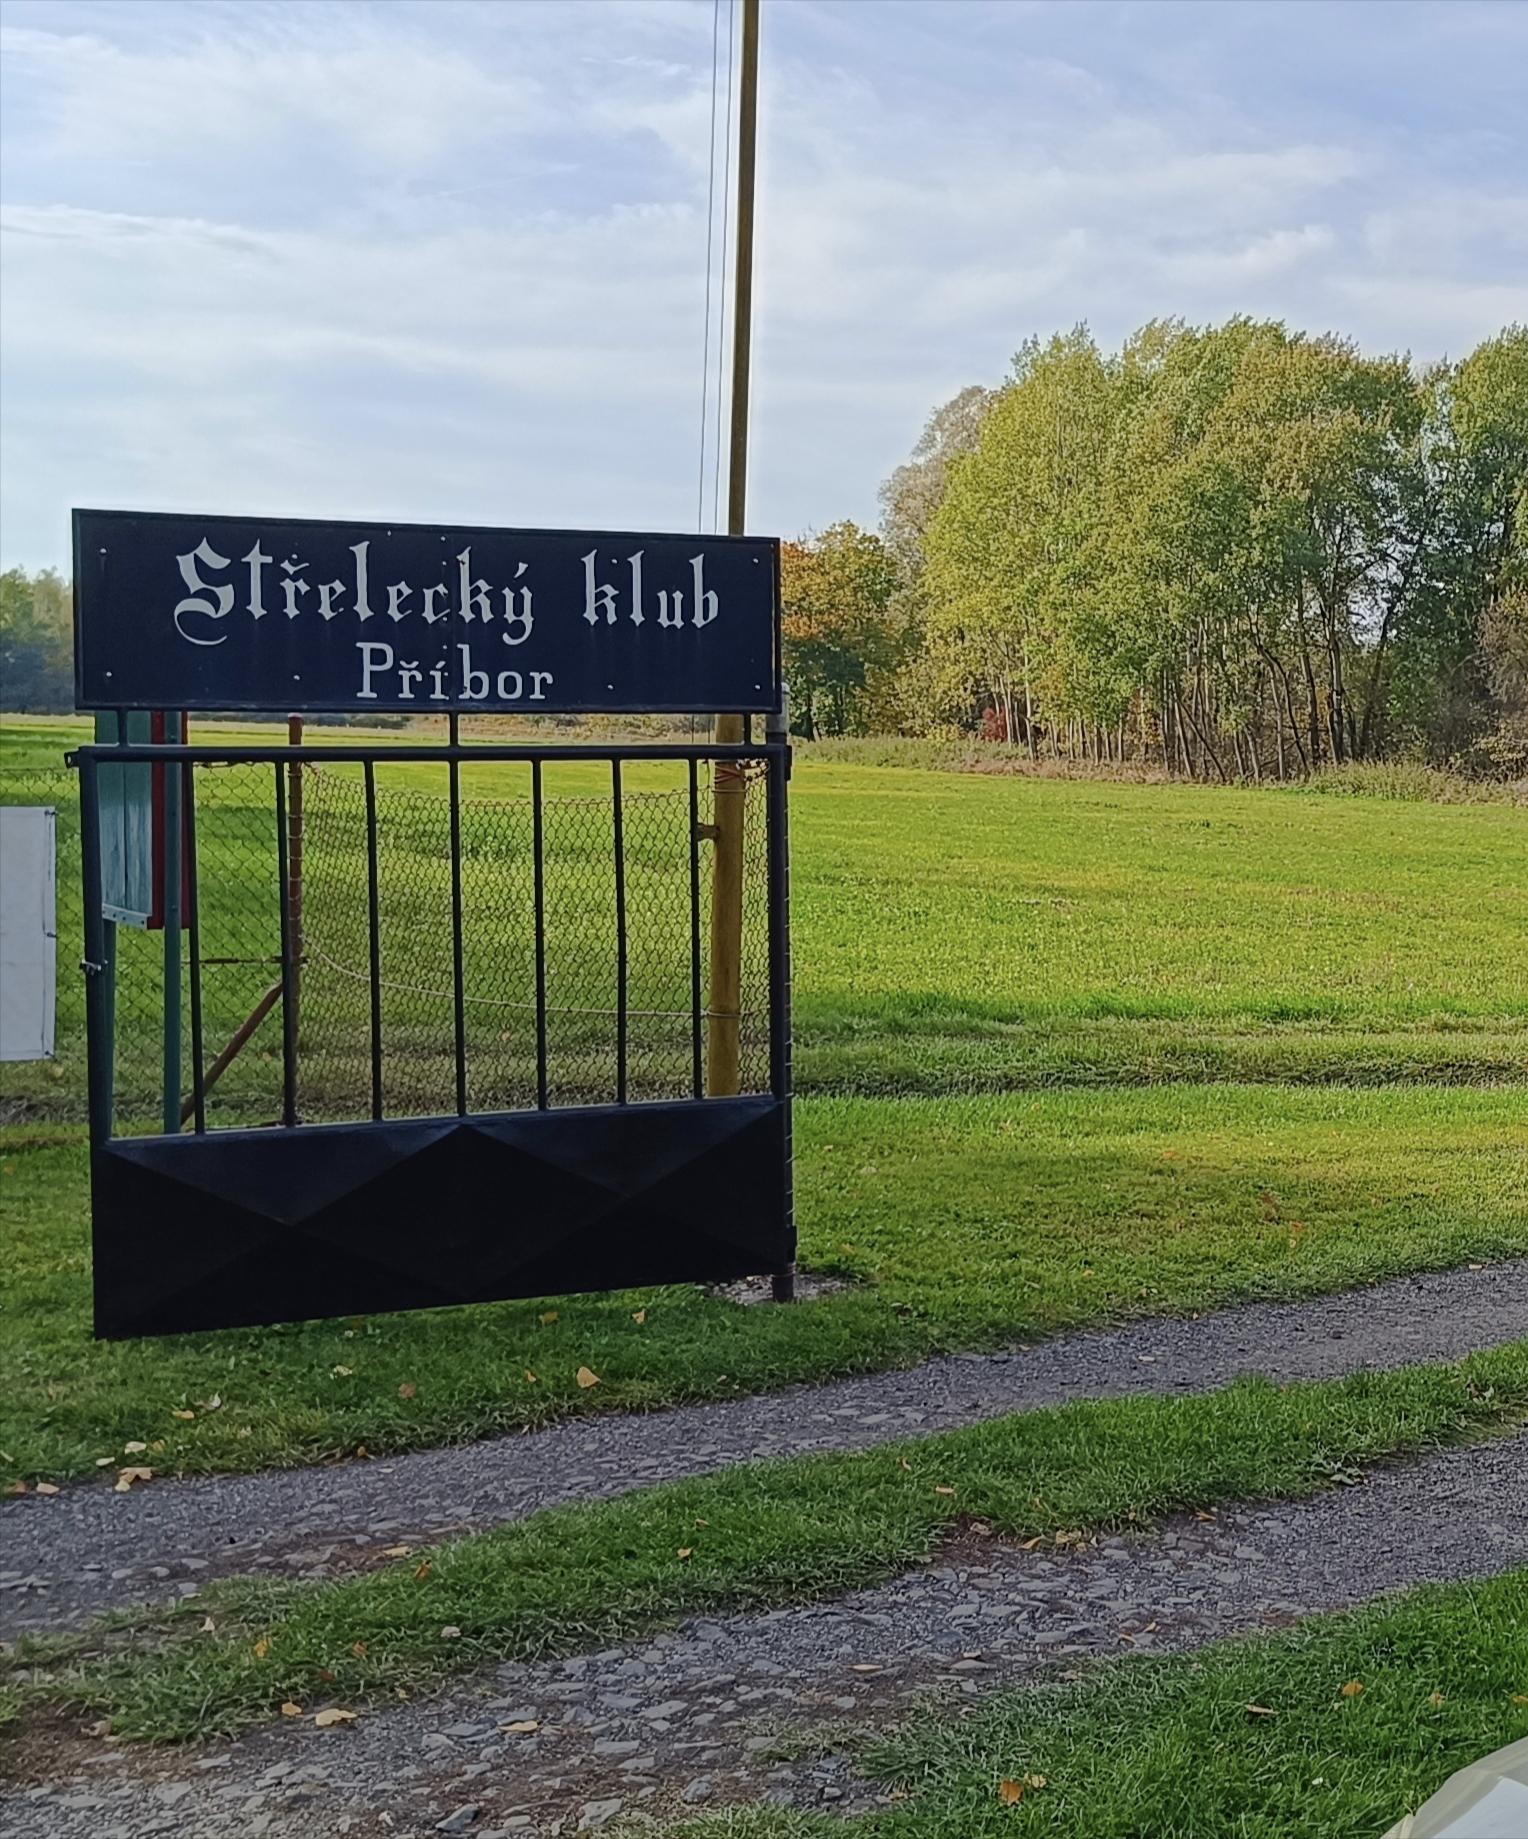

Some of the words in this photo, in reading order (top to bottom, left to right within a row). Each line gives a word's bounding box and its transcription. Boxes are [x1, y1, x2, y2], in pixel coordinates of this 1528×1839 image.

[173, 536, 535, 646] Střelecký
[581, 547, 721, 630] klub
[355, 641, 554, 700] Příbor
